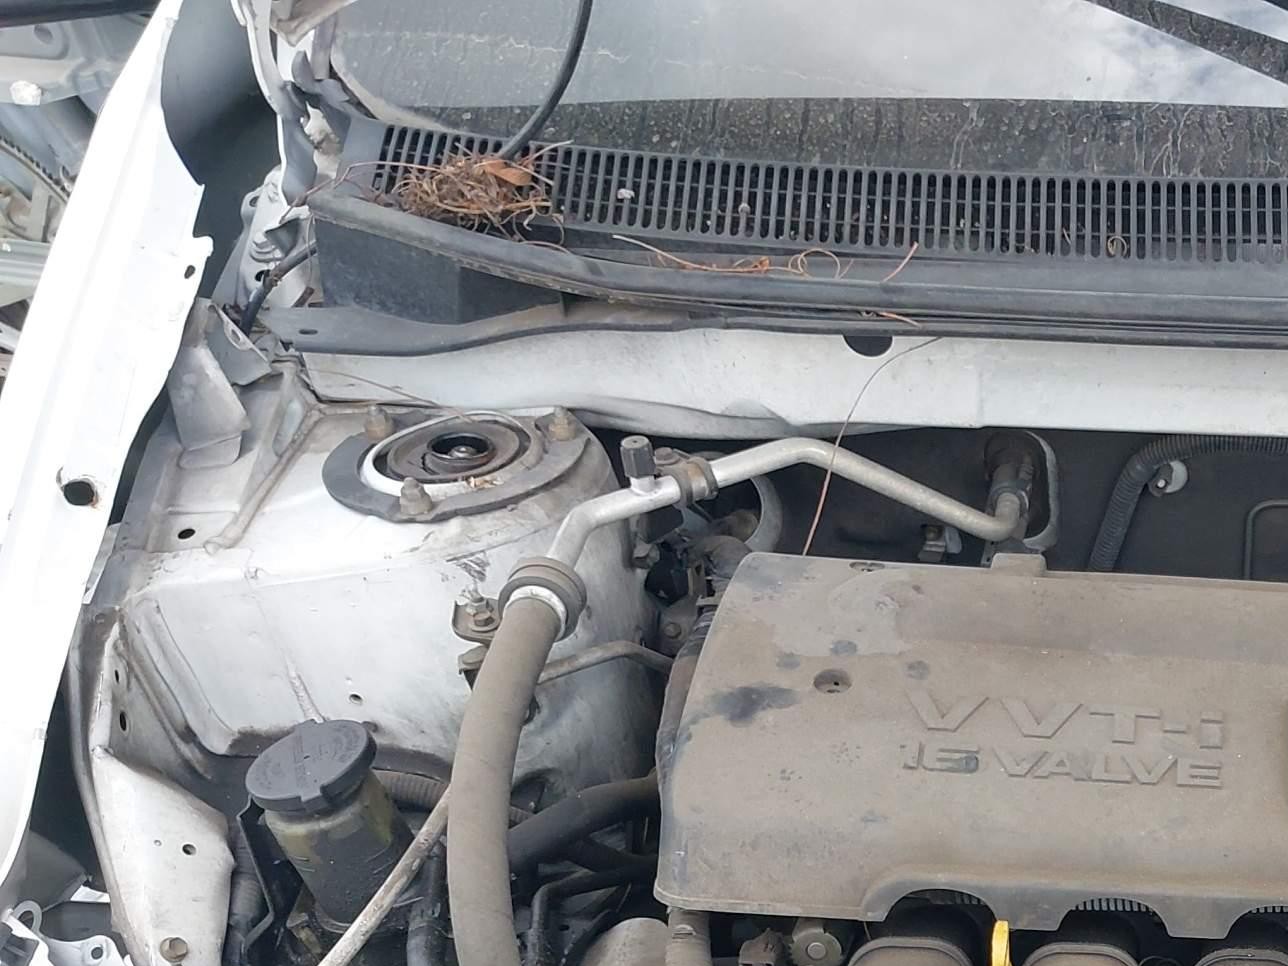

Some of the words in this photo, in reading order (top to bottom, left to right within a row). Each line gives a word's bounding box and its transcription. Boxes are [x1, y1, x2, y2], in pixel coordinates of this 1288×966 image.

[903, 688, 1224, 750] VVT-i
[898, 740, 981, 775] 16
[991, 746, 1225, 790] VALVE
